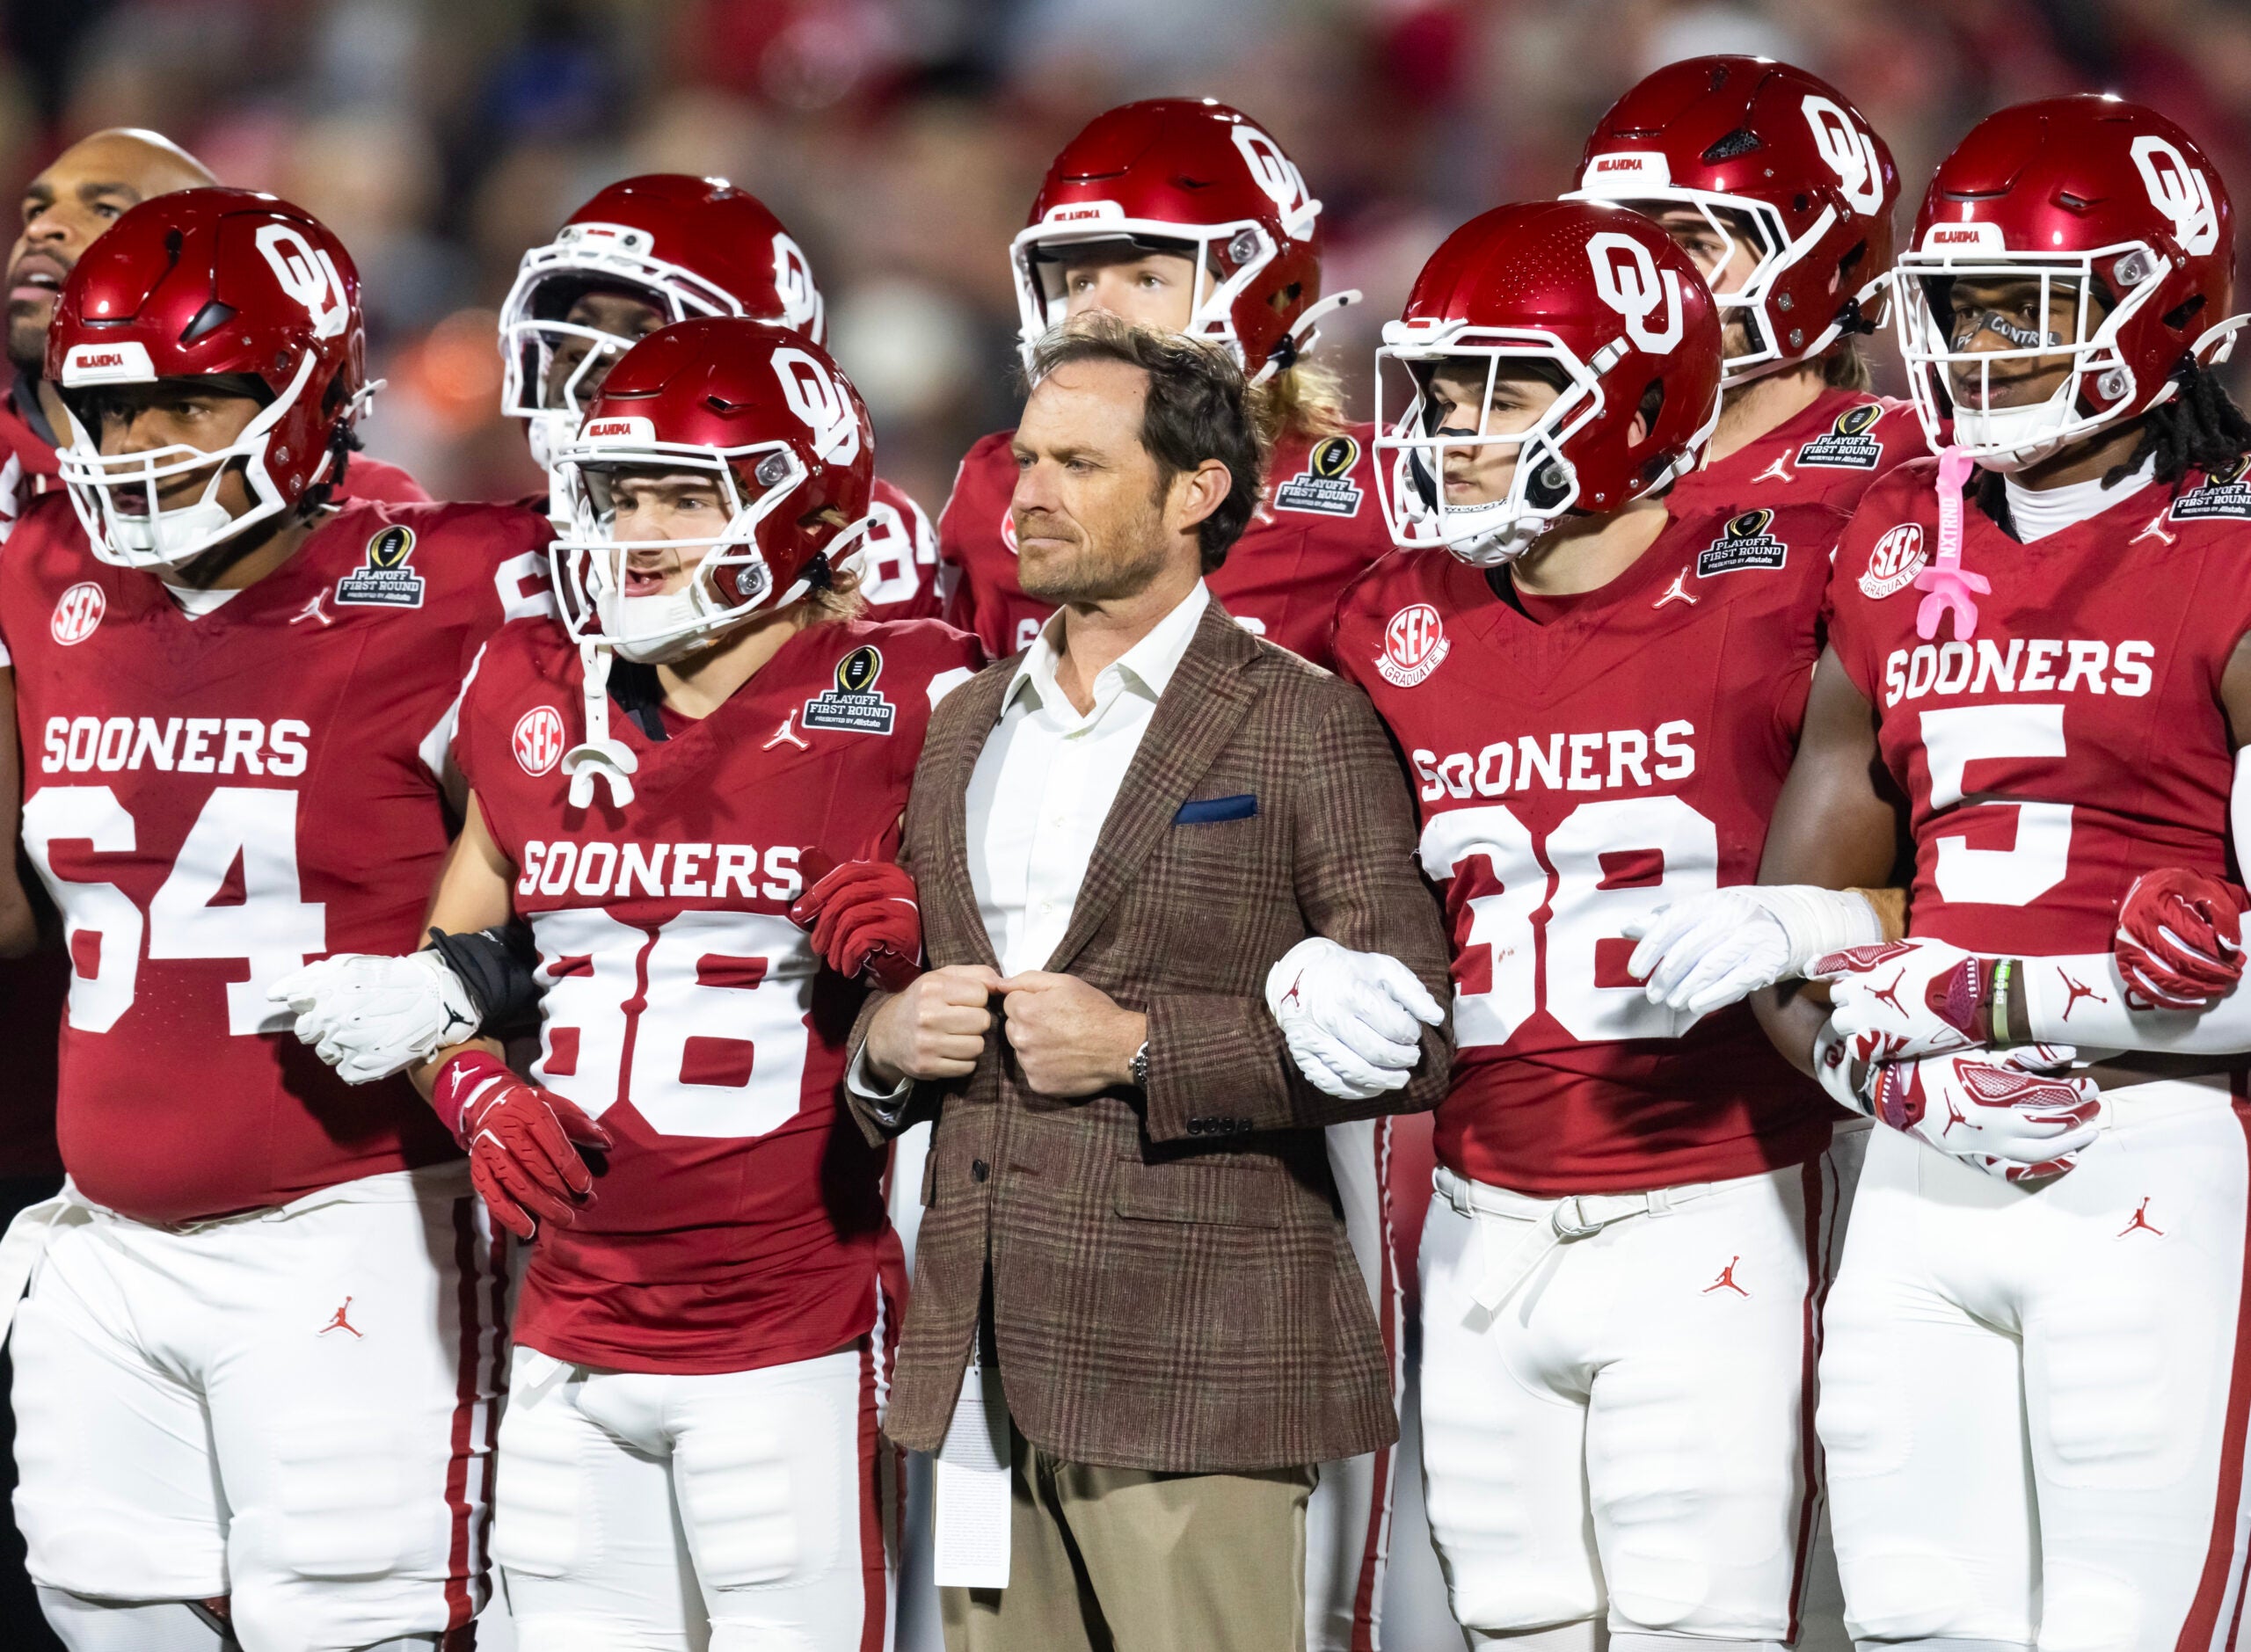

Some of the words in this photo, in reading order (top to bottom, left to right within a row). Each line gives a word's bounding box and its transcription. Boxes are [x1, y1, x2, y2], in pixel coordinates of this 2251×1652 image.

[1230, 125, 1315, 243] OU
[1801, 94, 1884, 216] OU
[2130, 135, 2220, 256] OU
[255, 223, 350, 338] OU
[1585, 232, 1684, 355] OU
[1991, 316, 2056, 346] CONTRL
[769, 347, 861, 467] OU
[1803, 446, 1837, 455] FIRST
[1837, 446, 1876, 455] ROUND
[1282, 485, 1317, 498] FIRST
[1317, 489, 1357, 502] ROUND
[1296, 477, 1349, 491] PLAYOFF
[2177, 496, 2211, 507] FIRST
[2192, 485, 2245, 498] PLAYOFF
[1702, 549, 1737, 564] FIRST
[1738, 547, 1781, 557] ROUND
[1716, 537, 1770, 551] PLAYOFF
[1874, 527, 1920, 578] SEC
[1939, 498, 1958, 558] NXTRND
[342, 580, 378, 591] FIRST
[379, 581, 419, 592] ROUND
[357, 571, 408, 580] PLAYOFF
[1863, 566, 1919, 597] GRADUATE
[55, 586, 101, 640] SEC
[1390, 608, 1436, 666] SEC
[1384, 653, 1440, 686] GRADUATE
[1884, 638, 2155, 709] SOONERS
[809, 703, 846, 714] FIRST
[847, 705, 890, 718] ROUND
[824, 694, 878, 705] PLAYOFF
[41, 717, 310, 777] SOONERS
[517, 711, 559, 771] SEC
[1412, 719, 1695, 802] SOONERS
[1919, 703, 2074, 906] 5
[519, 840, 803, 900] SOONERS
[22, 785, 327, 1036] 64
[1418, 795, 1719, 1049] 38
[527, 907, 820, 1138] 88
